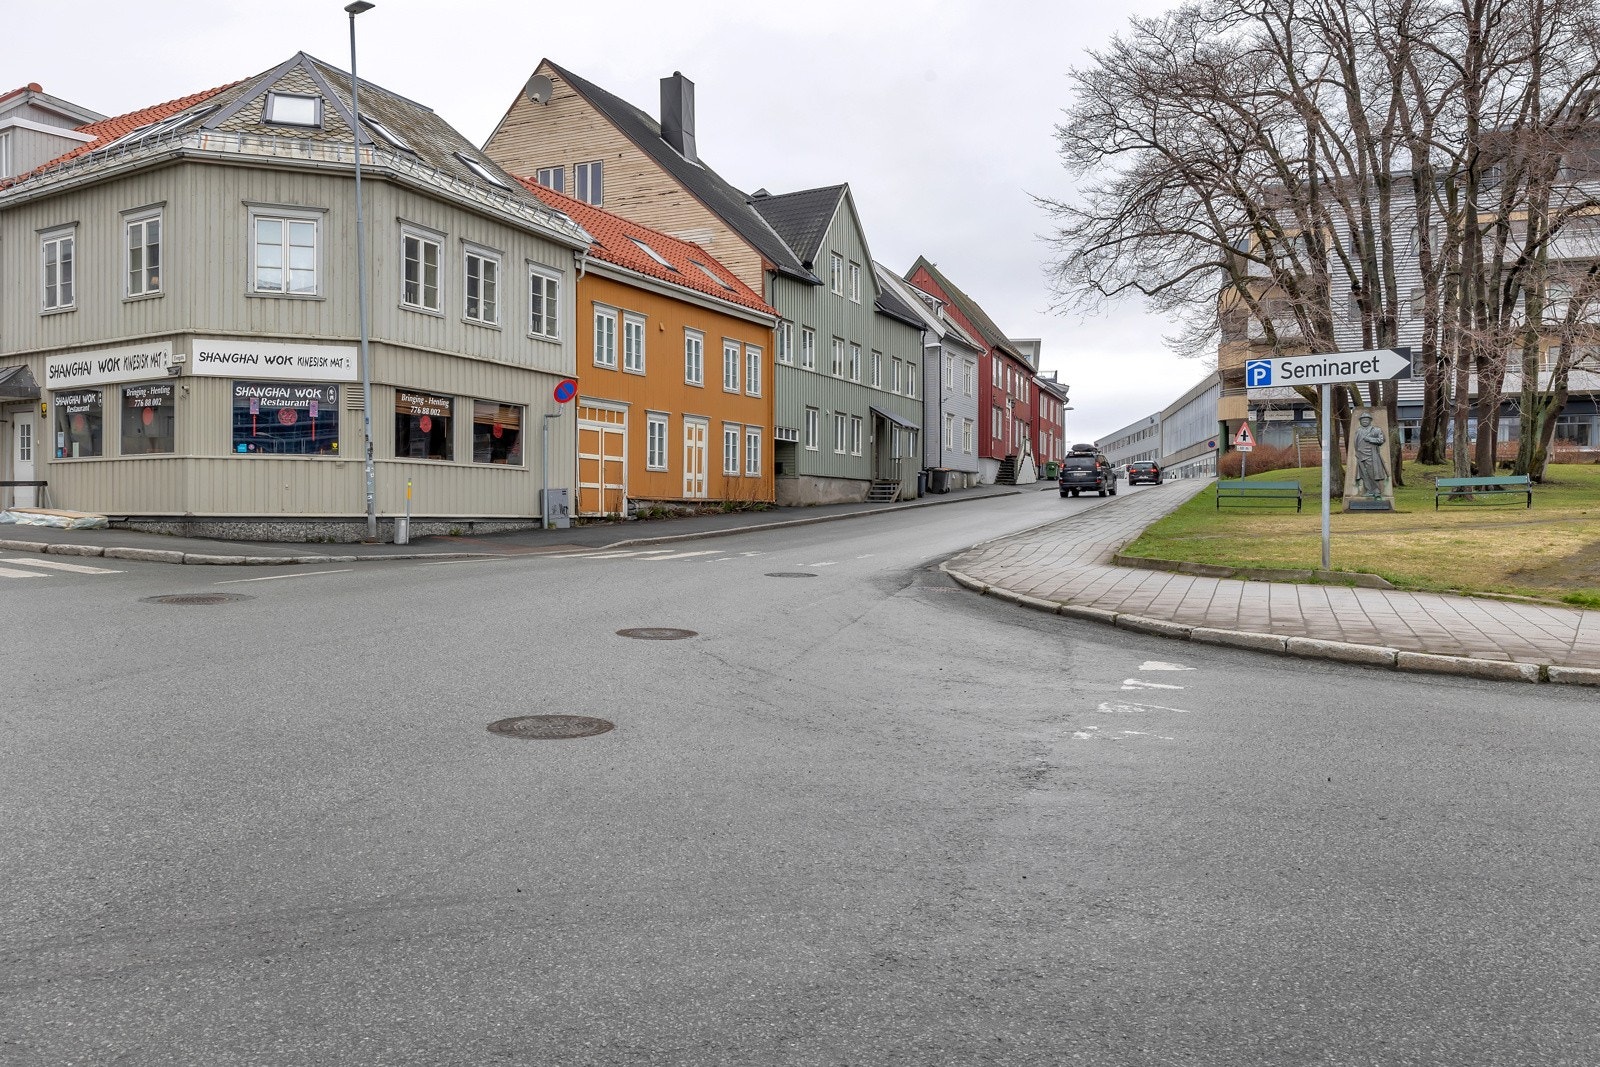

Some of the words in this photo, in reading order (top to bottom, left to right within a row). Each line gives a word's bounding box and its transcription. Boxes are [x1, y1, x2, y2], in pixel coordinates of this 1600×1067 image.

[49, 360, 92, 379] SHANGHAI
[98, 357, 120, 373] WOK
[123, 353, 149, 371] KINESISK
[150, 351, 162, 368] MAT
[199, 351, 259, 364] SHANGHAI
[264, 355, 293, 366] WOK
[297, 355, 328, 368] KINESISK
[330, 357, 344, 369] MAT
[1281, 355, 1380, 380] Seminaret
[126, 387, 147, 398] Bringing
[150, 386, 171, 396] Henting
[235, 386, 290, 398] SHANGHAI
[294, 388, 322, 399] WOK
[55, 395, 81, 406] SHANGHAI
[82, 393, 96, 403] WOK
[134, 399, 144, 407] 776
[260, 398, 310, 407] Restaurant
[401, 393, 424, 405] Bringing
[428, 397, 449, 408] Henting
[66, 404, 90, 413] Restaurant
[410, 406, 421, 414] 776
